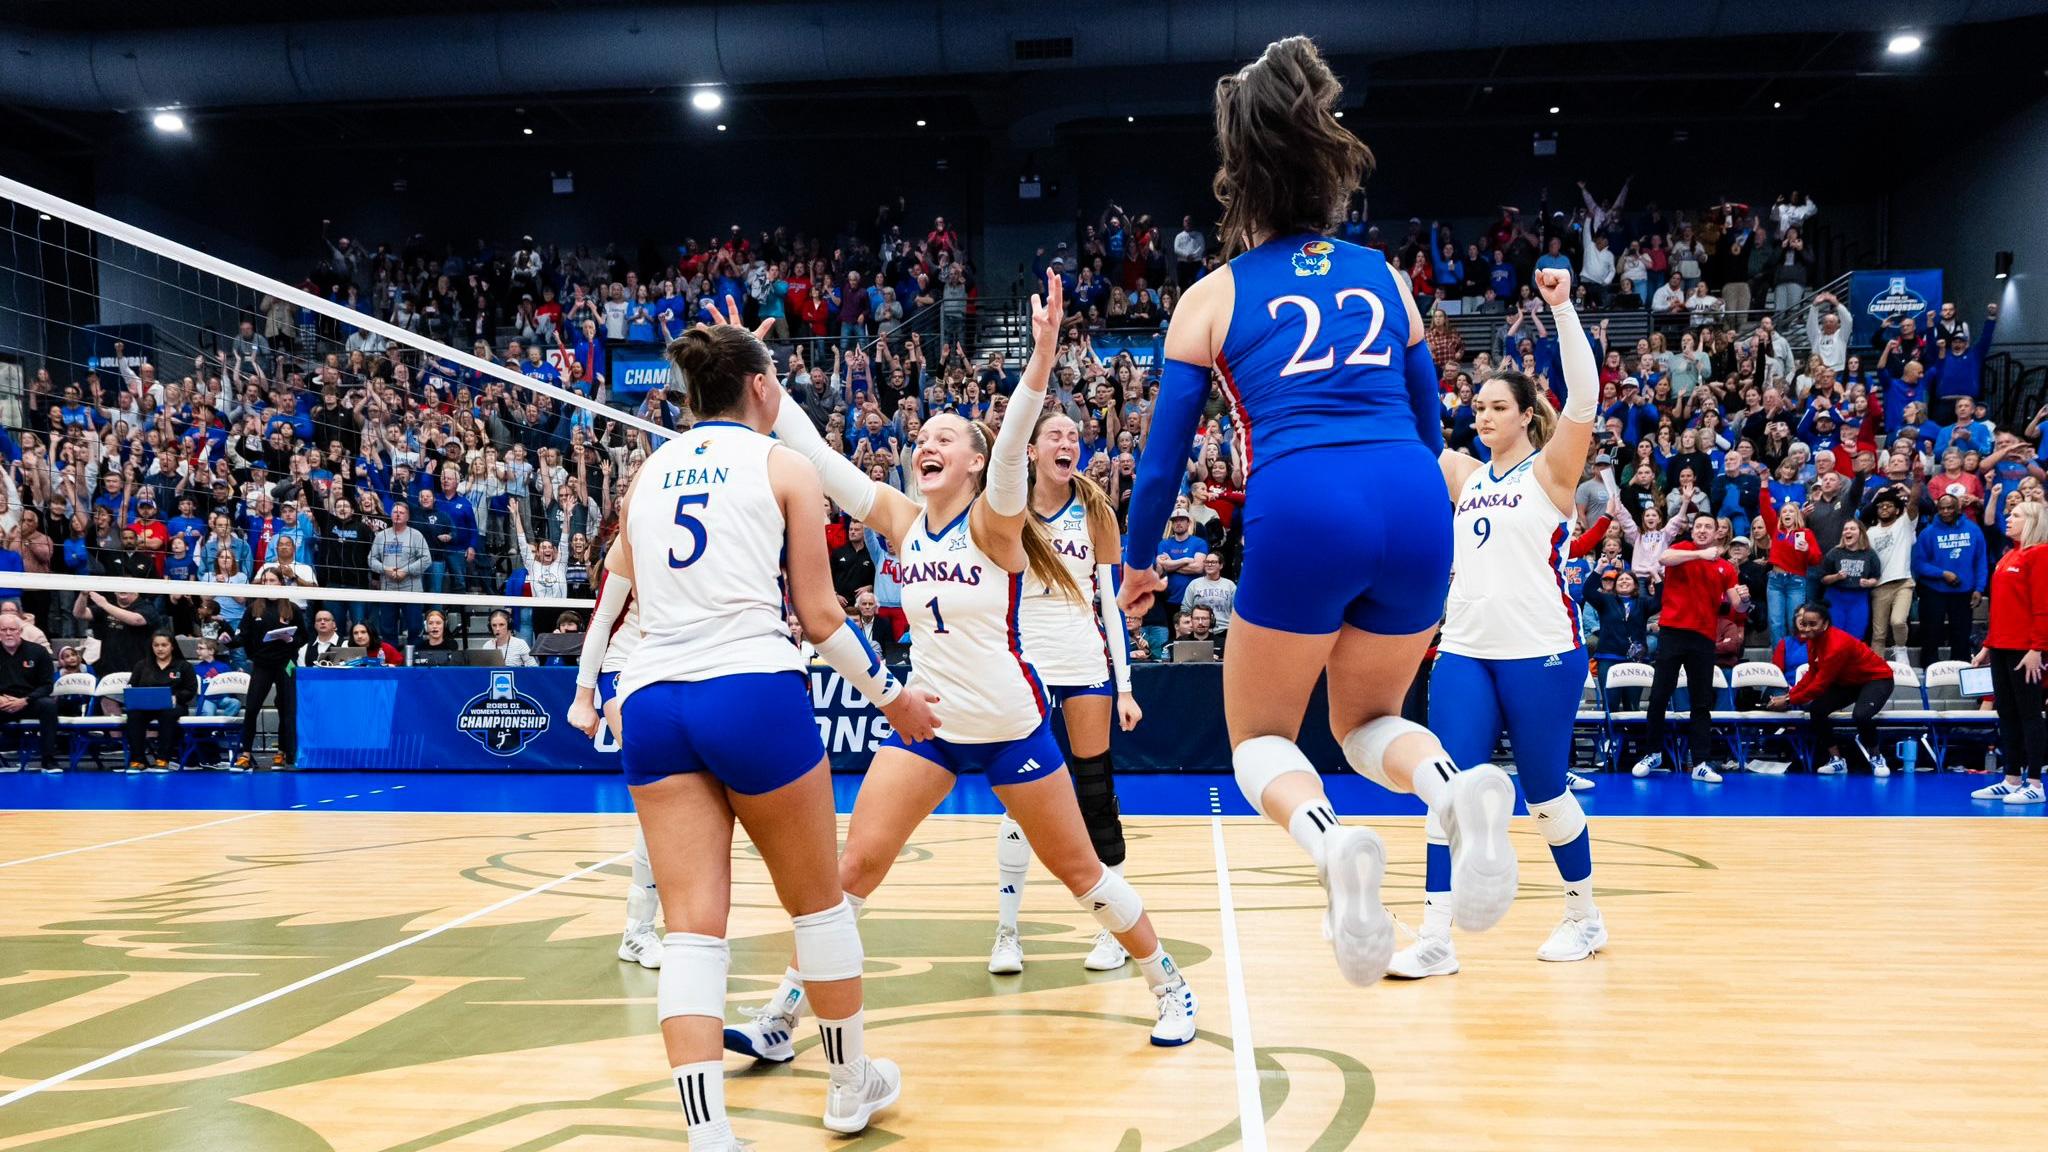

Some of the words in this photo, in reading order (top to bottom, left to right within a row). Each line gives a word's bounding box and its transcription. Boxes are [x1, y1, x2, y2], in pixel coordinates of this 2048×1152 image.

[1870, 303, 1925, 312] CHAMPIONSHIP
[1267, 288, 1391, 377] 22
[663, 467, 729, 489] LEBAN
[1457, 493, 1522, 516] KANSAS
[668, 493, 710, 569] 5
[1473, 517, 1491, 549] 9
[902, 561, 982, 588] KANSAS
[1196, 588, 1229, 600] KANSAS
[925, 596, 950, 634] 1
[1612, 668, 1654, 678] KANSAS
[1737, 667, 1780, 678] KANSAS
[56, 678, 91, 687] KANSAS
[212, 677, 247, 687] KANSAS
[460, 717, 546, 728] CHAMPIONSHIP
